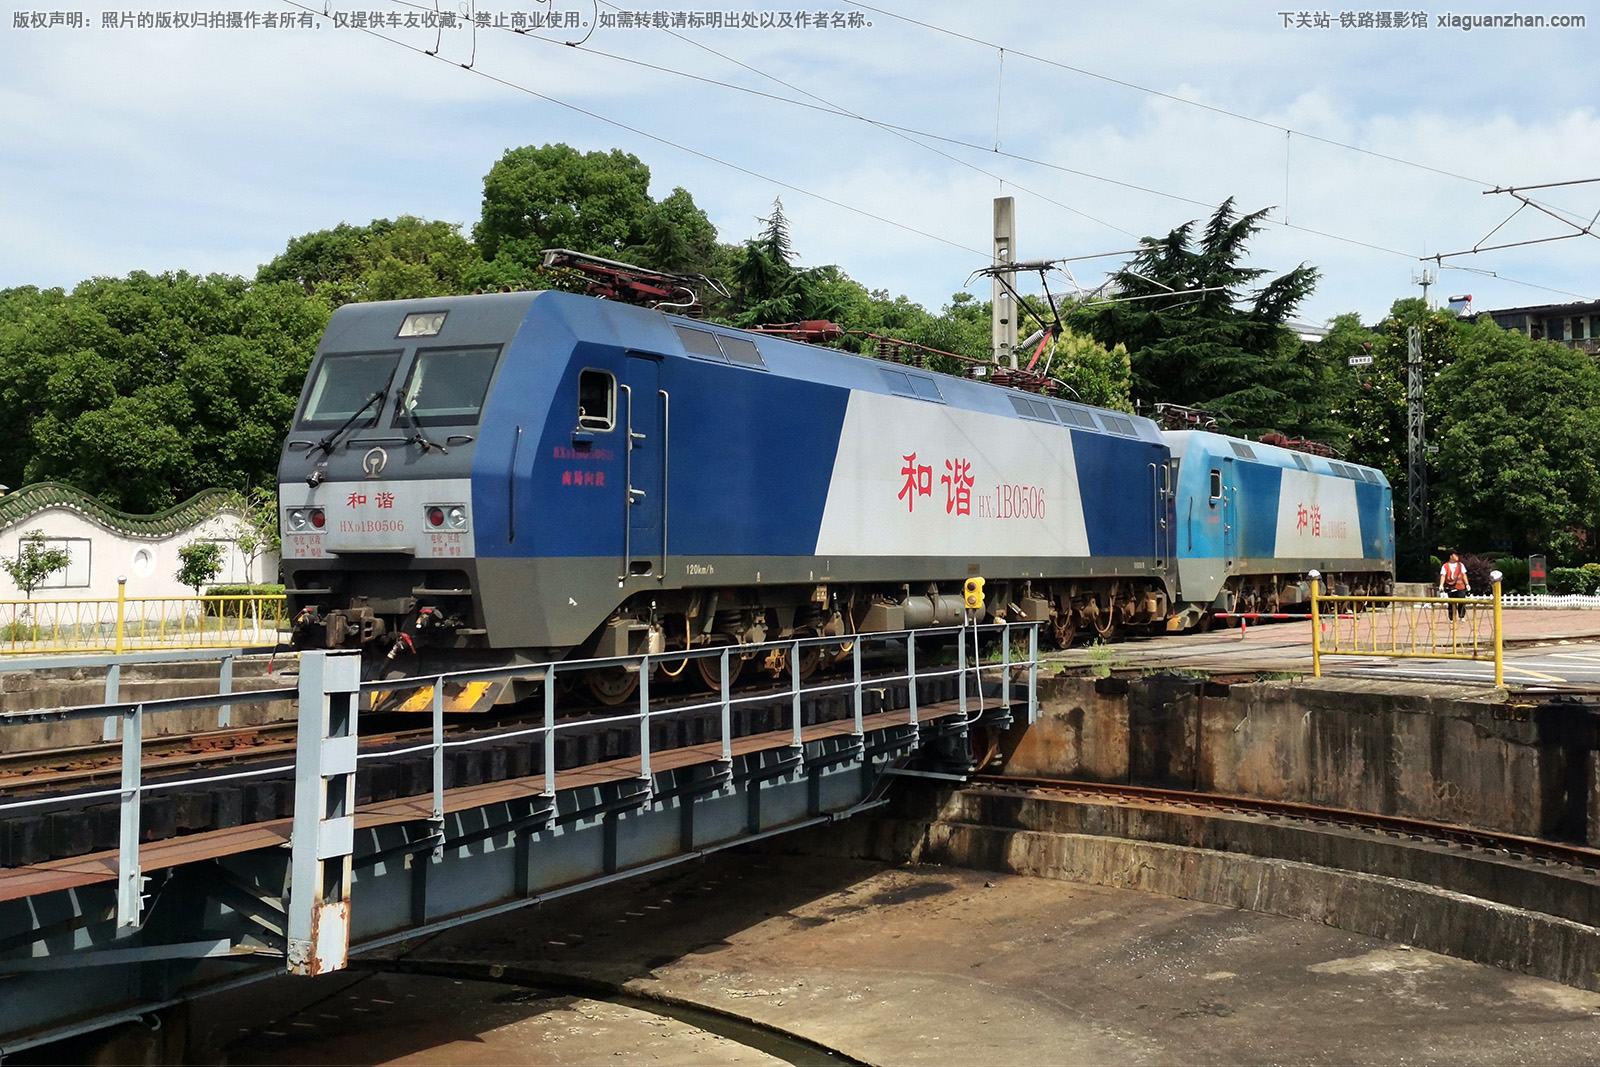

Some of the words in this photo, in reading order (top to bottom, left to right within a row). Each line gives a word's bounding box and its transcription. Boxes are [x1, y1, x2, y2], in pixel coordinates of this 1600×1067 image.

[898, 452, 975, 516] 和谐
[347, 492, 395, 509] 和谐
[1296, 502, 1321, 537] 和谐
[686, 564, 714, 575] 120km/h
